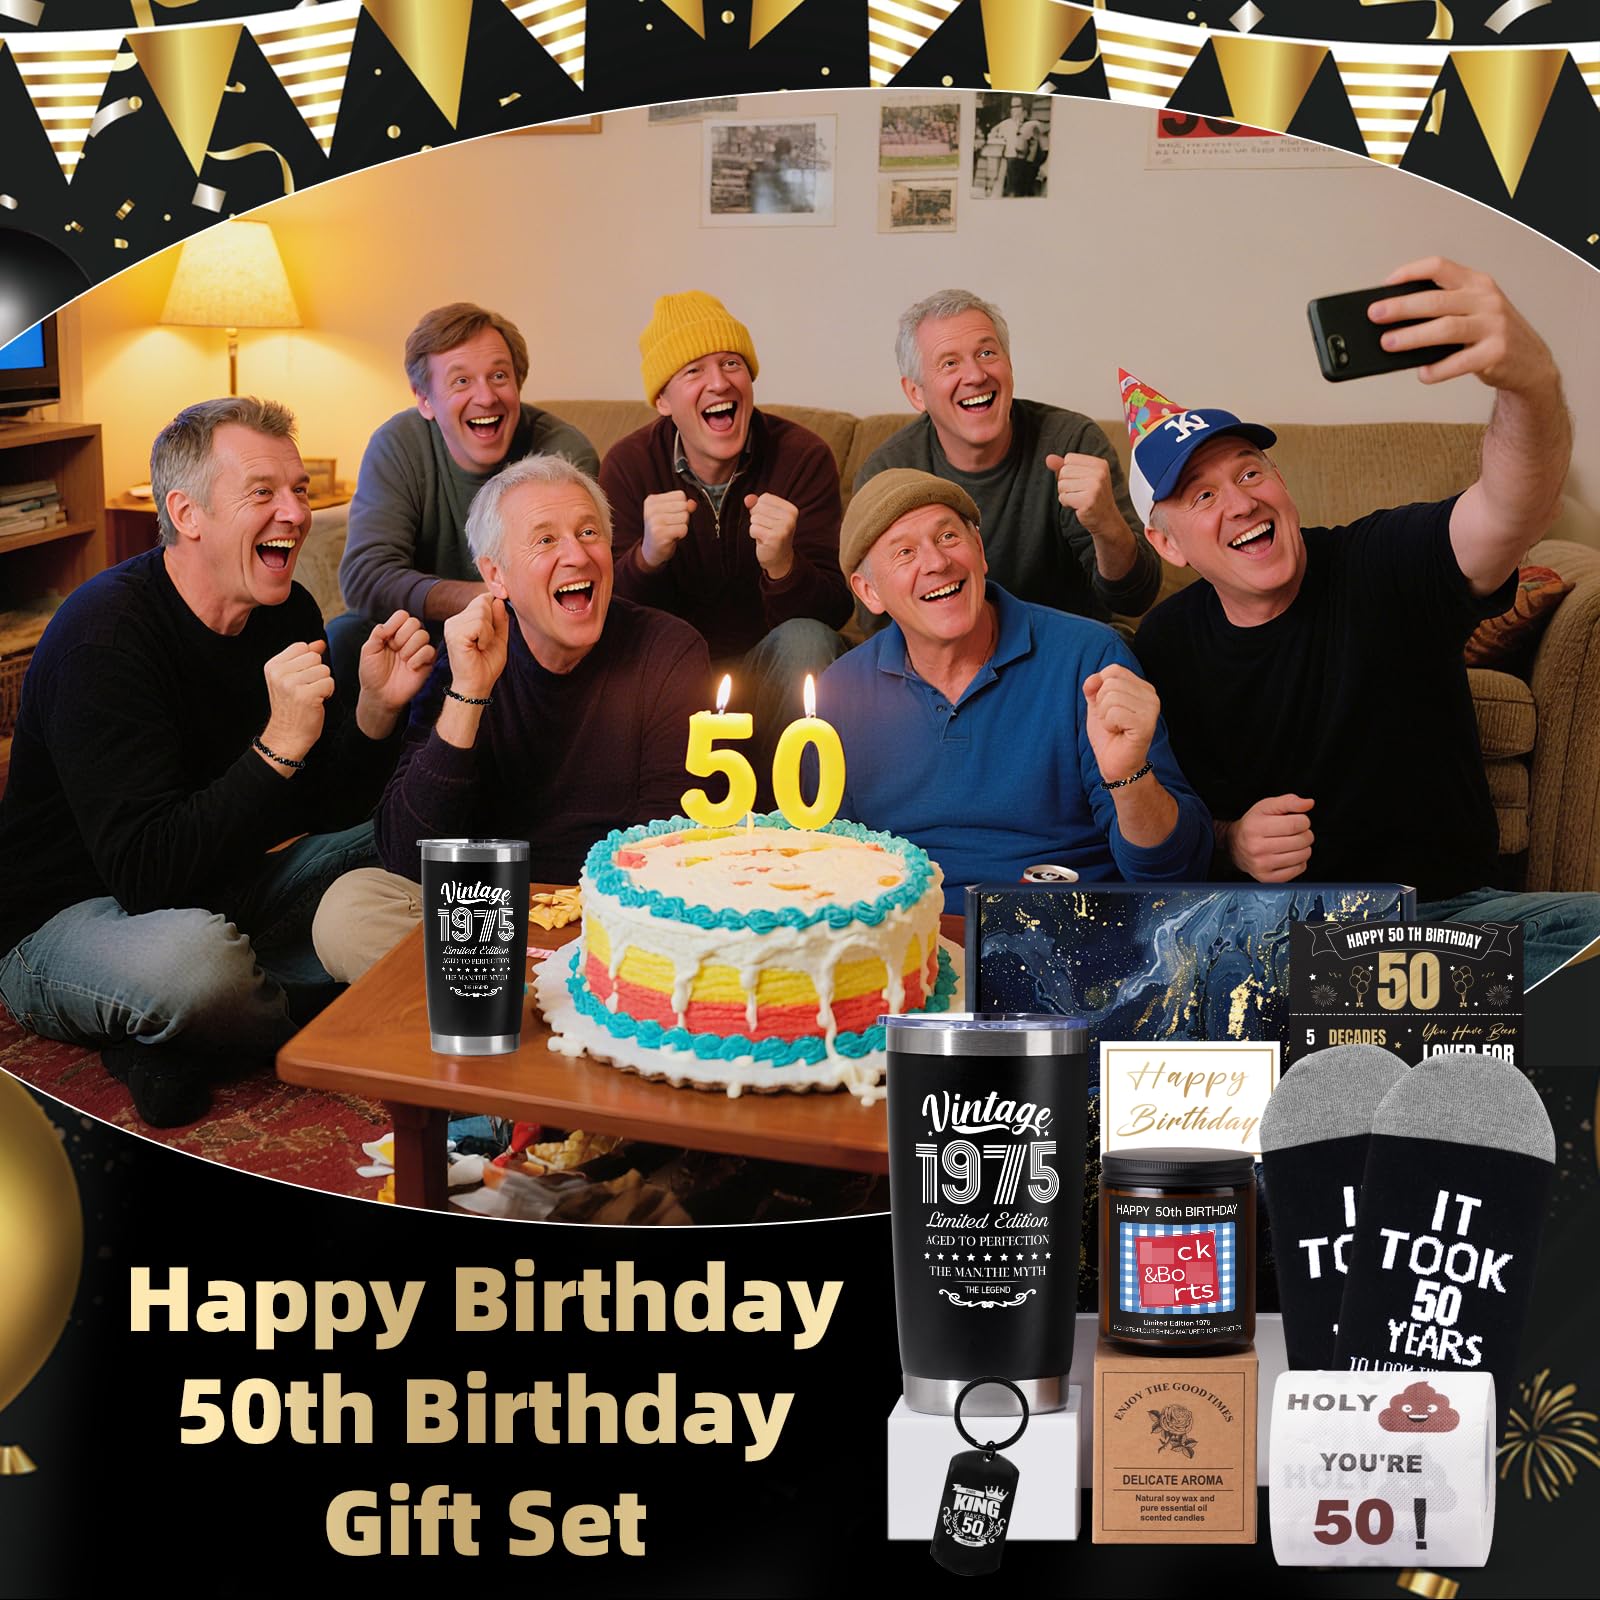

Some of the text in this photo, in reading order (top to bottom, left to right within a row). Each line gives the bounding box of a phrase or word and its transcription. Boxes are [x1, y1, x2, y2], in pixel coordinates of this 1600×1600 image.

[680, 711, 846, 830] 50
[441, 881, 511, 905] Vintage
[438, 907, 514, 942] 1975
[1346, 927, 1482, 950] HAPPY 50 TH BIRTHDAY
[442, 945, 510, 955] Limited Edition
[1377, 952, 1440, 1010] 50
[1306, 1029, 1387, 1046] 5 DECADES
[1422, 1023, 1518, 1042] You Have Been
[1127, 1061, 1248, 1098] Happy
[922, 1090, 1053, 1137] Vintage
[1116, 1103, 1259, 1144] Birthday
[915, 1139, 1060, 1204] 1975
[925, 1211, 1050, 1229] Limited Edition
[1116, 1203, 1238, 1217] HAPPY 50th BIRTHDAY
[1431, 1190, 1482, 1236] IT
[925, 1234, 1050, 1247] AGED TO PERFECTION
[1380, 1227, 1513, 1293] TOOK
[929, 1265, 951, 1277] THE
[1013, 1265, 1046, 1278] MYTH
[965, 1286, 1011, 1294] THE LEGEND
[1410, 1279, 1462, 1327] 50
[1169, 1320, 1195, 1328] Edition
[1388, 1318, 1483, 1367] YEARS
[1114, 1391, 1144, 1421] ENJOY
[1145, 1382, 1170, 1395] THE
[1287, 1394, 1378, 1412] HOLY
[1320, 1453, 1423, 1473] YOU'RE
[1122, 1475, 1223, 1485] DELICATE AROMA
[953, 1493, 1001, 1519] KING
[1135, 1494, 1164, 1502] Natural
[1166, 1495, 1181, 1503] soy
[1140, 1504, 1208, 1513] pure essential oil
[961, 1516, 984, 1537] 50
[964, 1511, 986, 1521] MAKES
[1140, 1514, 1205, 1522] scented candles
[1313, 1498, 1394, 1546] 50
